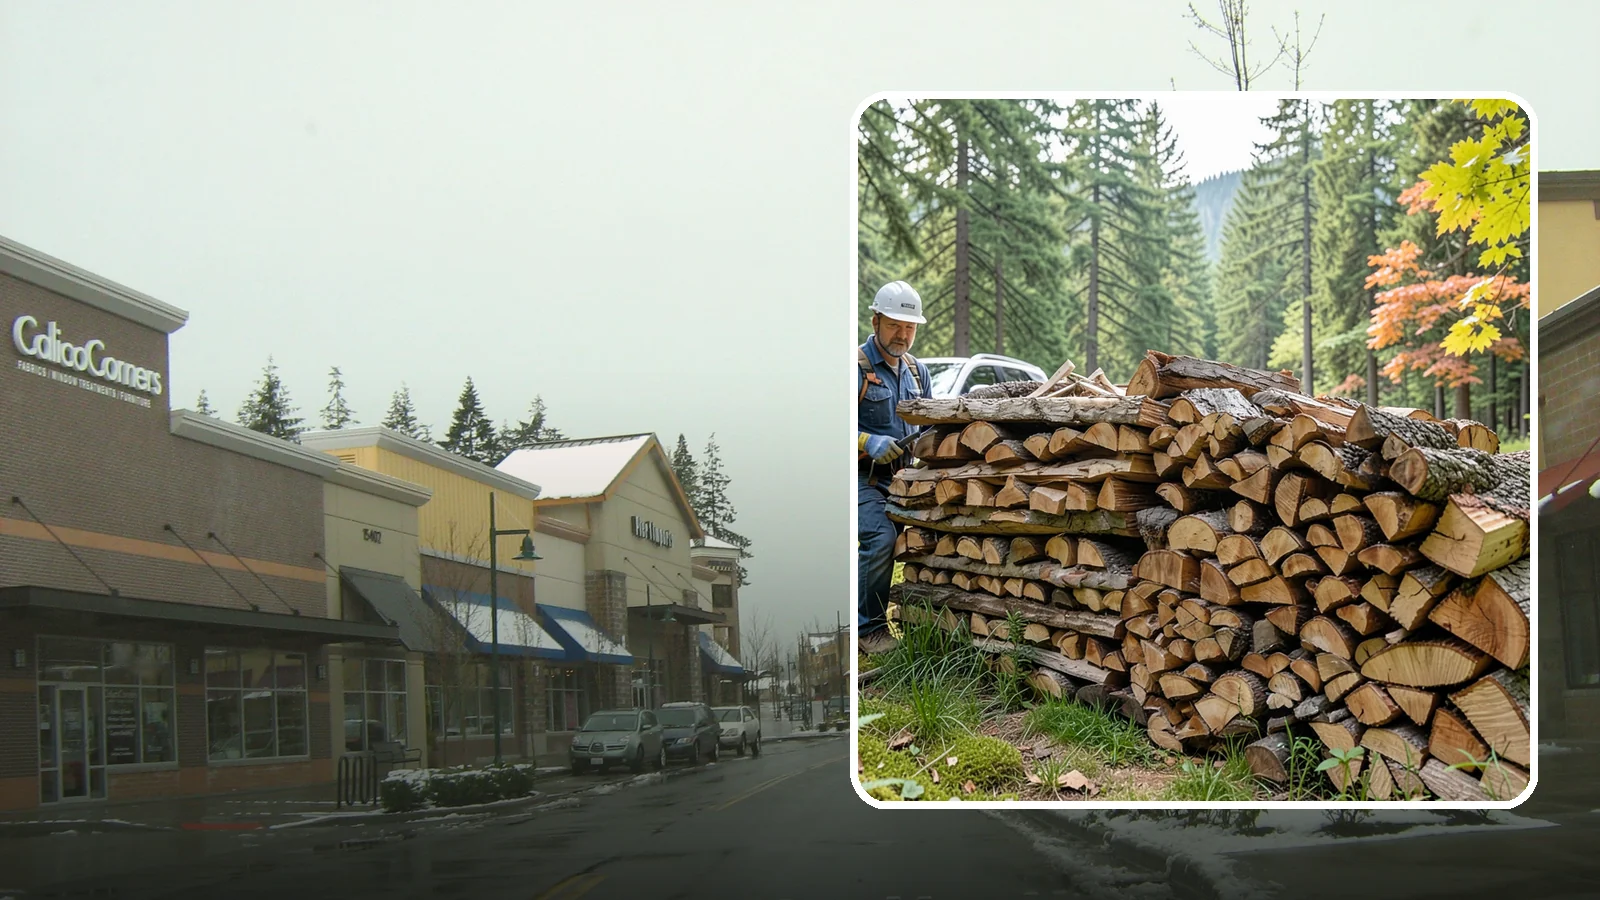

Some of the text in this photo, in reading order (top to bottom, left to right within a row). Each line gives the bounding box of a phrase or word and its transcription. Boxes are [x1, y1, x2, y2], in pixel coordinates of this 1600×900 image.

[17, 360, 47, 378] FABRICS
[51, 370, 78, 386] WINDOW
[78, 378, 116, 398] TREATMENTS
[120, 391, 151, 408] FURNITURE
